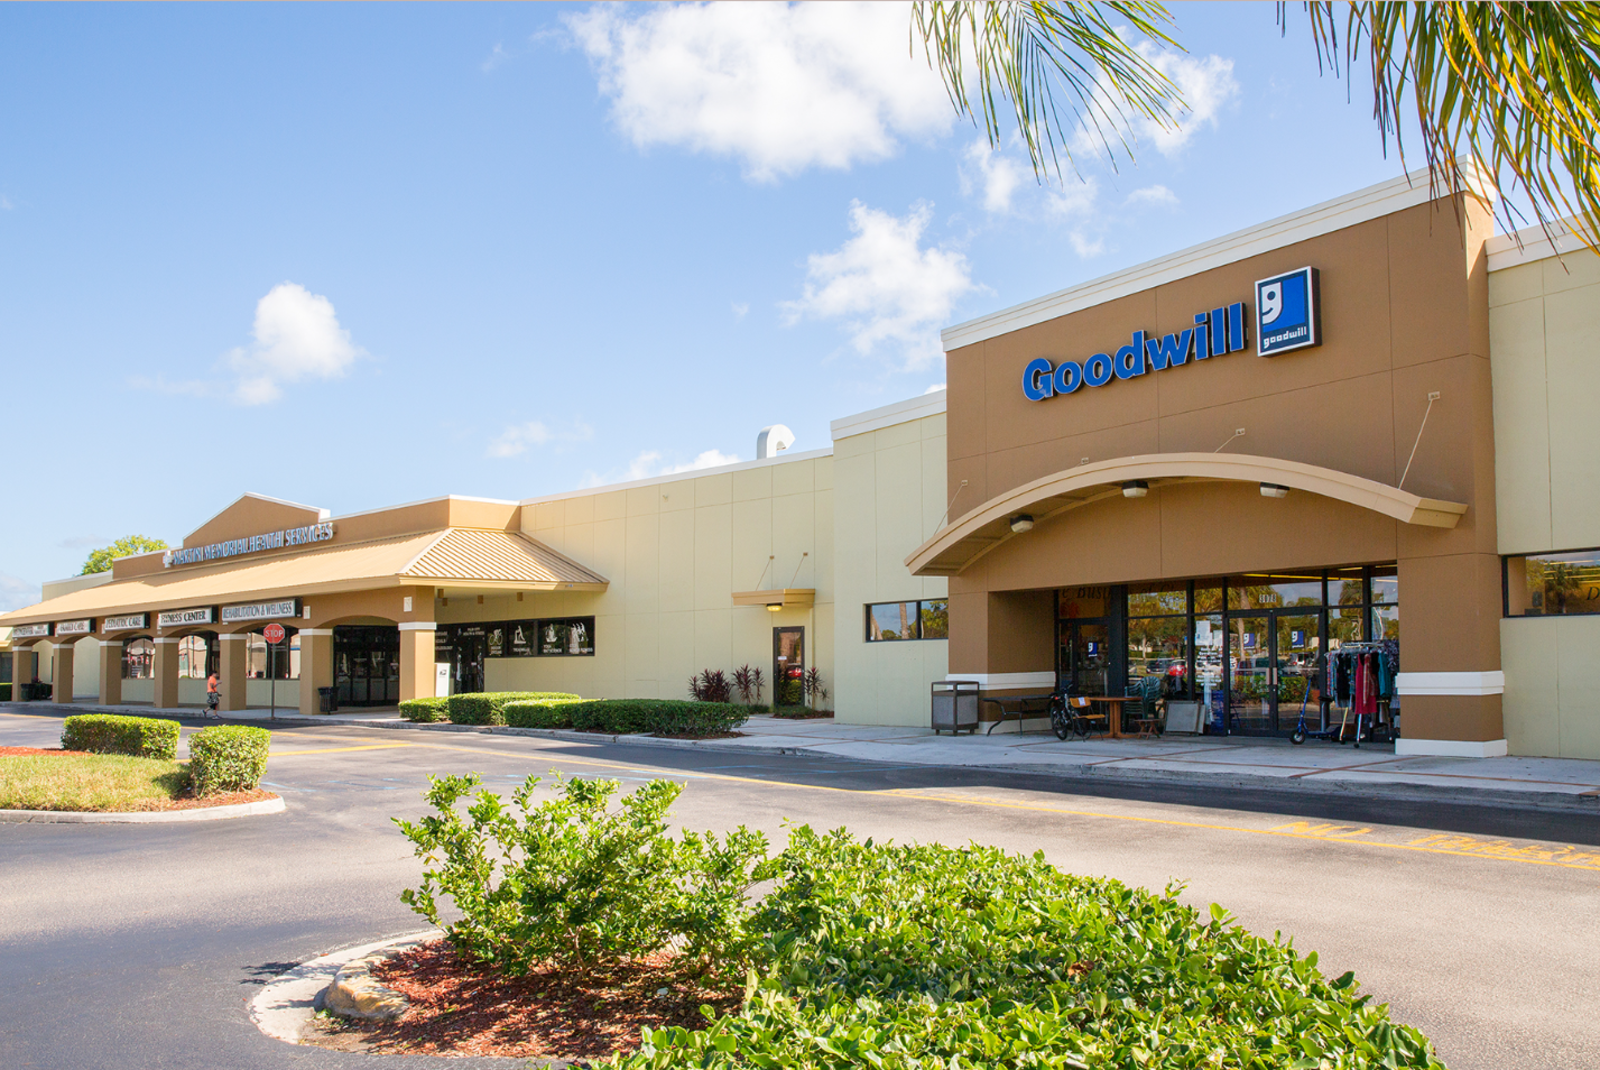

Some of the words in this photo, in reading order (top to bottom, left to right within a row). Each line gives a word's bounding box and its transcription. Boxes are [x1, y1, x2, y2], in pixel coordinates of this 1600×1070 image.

[1264, 326, 1307, 349] goodwill
[1022, 302, 1245, 401] Goodwill
[172, 547, 203, 565] MARTIN
[203, 538, 249, 560] MEMORIAL
[249, 531, 284, 551] HEALTH
[285, 522, 333, 546] SERVICES
[161, 612, 183, 624] FITNESS
[183, 610, 206, 622] CENTER
[222, 605, 260, 619] REHABILITATION
[266, 602, 292, 616] WELLNESS
[128, 616, 141, 627] CARE
